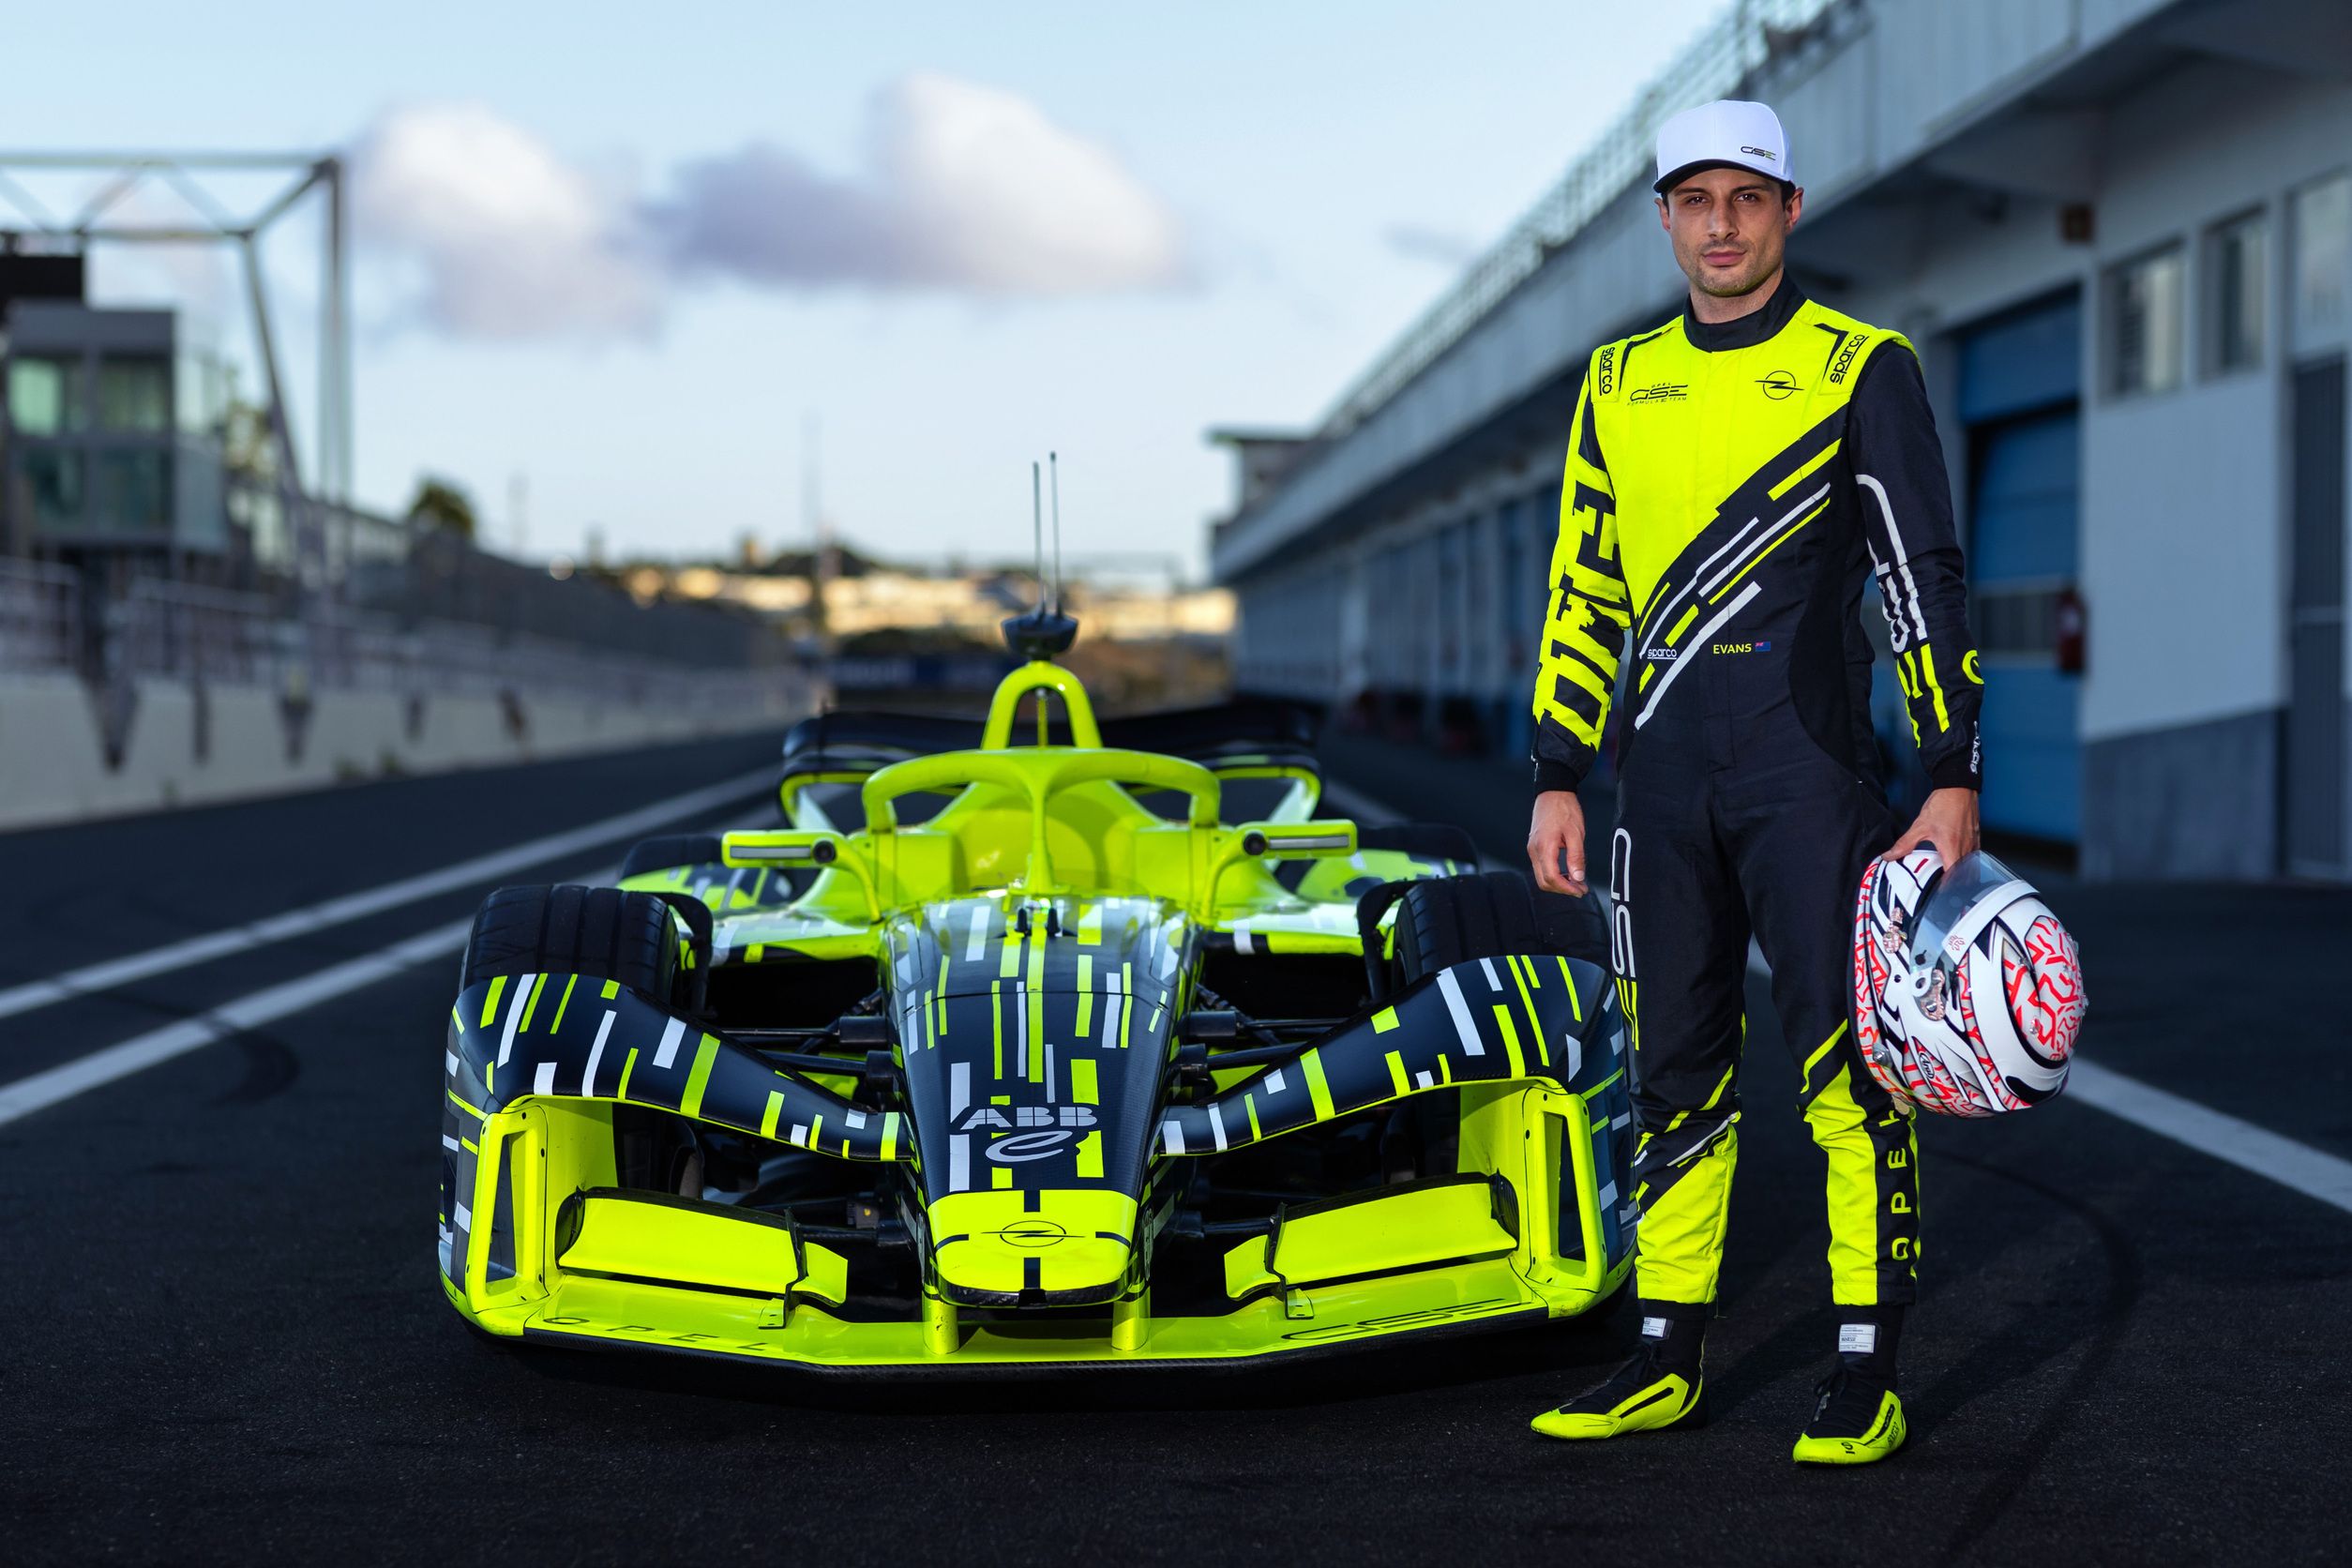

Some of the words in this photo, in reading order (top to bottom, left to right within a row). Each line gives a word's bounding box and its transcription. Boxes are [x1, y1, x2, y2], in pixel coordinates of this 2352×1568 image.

[1741, 145, 1776, 160] GSE
[1830, 334, 1869, 384] sparco
[1599, 346, 1616, 396] sparco
[1630, 384, 1688, 401] GSE
[1647, 648, 1678, 660] sparco
[1712, 643, 1752, 655] EVANS
[959, 1106, 1098, 1130] ABB
[543, 1317, 768, 1350] OPEL
